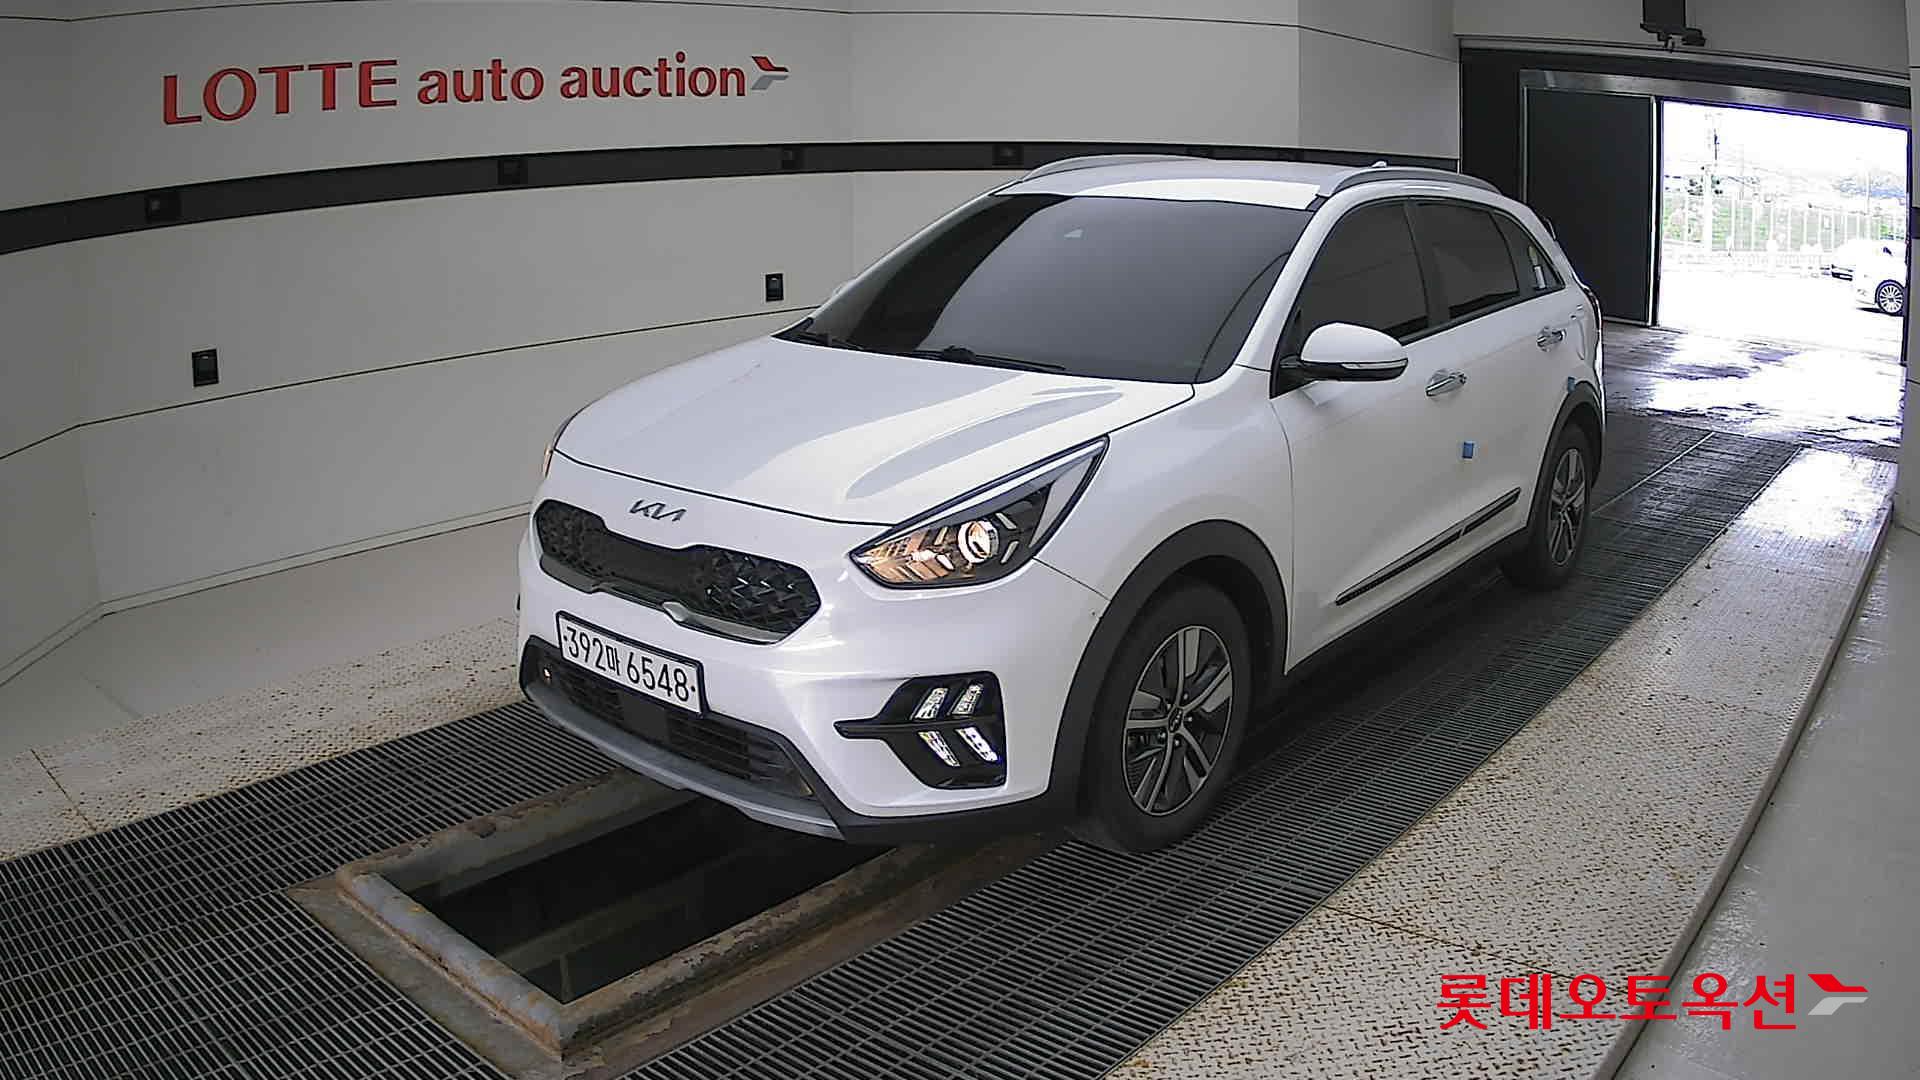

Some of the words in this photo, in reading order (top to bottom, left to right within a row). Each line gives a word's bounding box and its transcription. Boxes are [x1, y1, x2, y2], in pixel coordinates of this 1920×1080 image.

[163, 59, 398, 125] LOTTE
[417, 58, 545, 104] auto
[560, 51, 747, 99] auction
[626, 652, 690, 702] 6548
